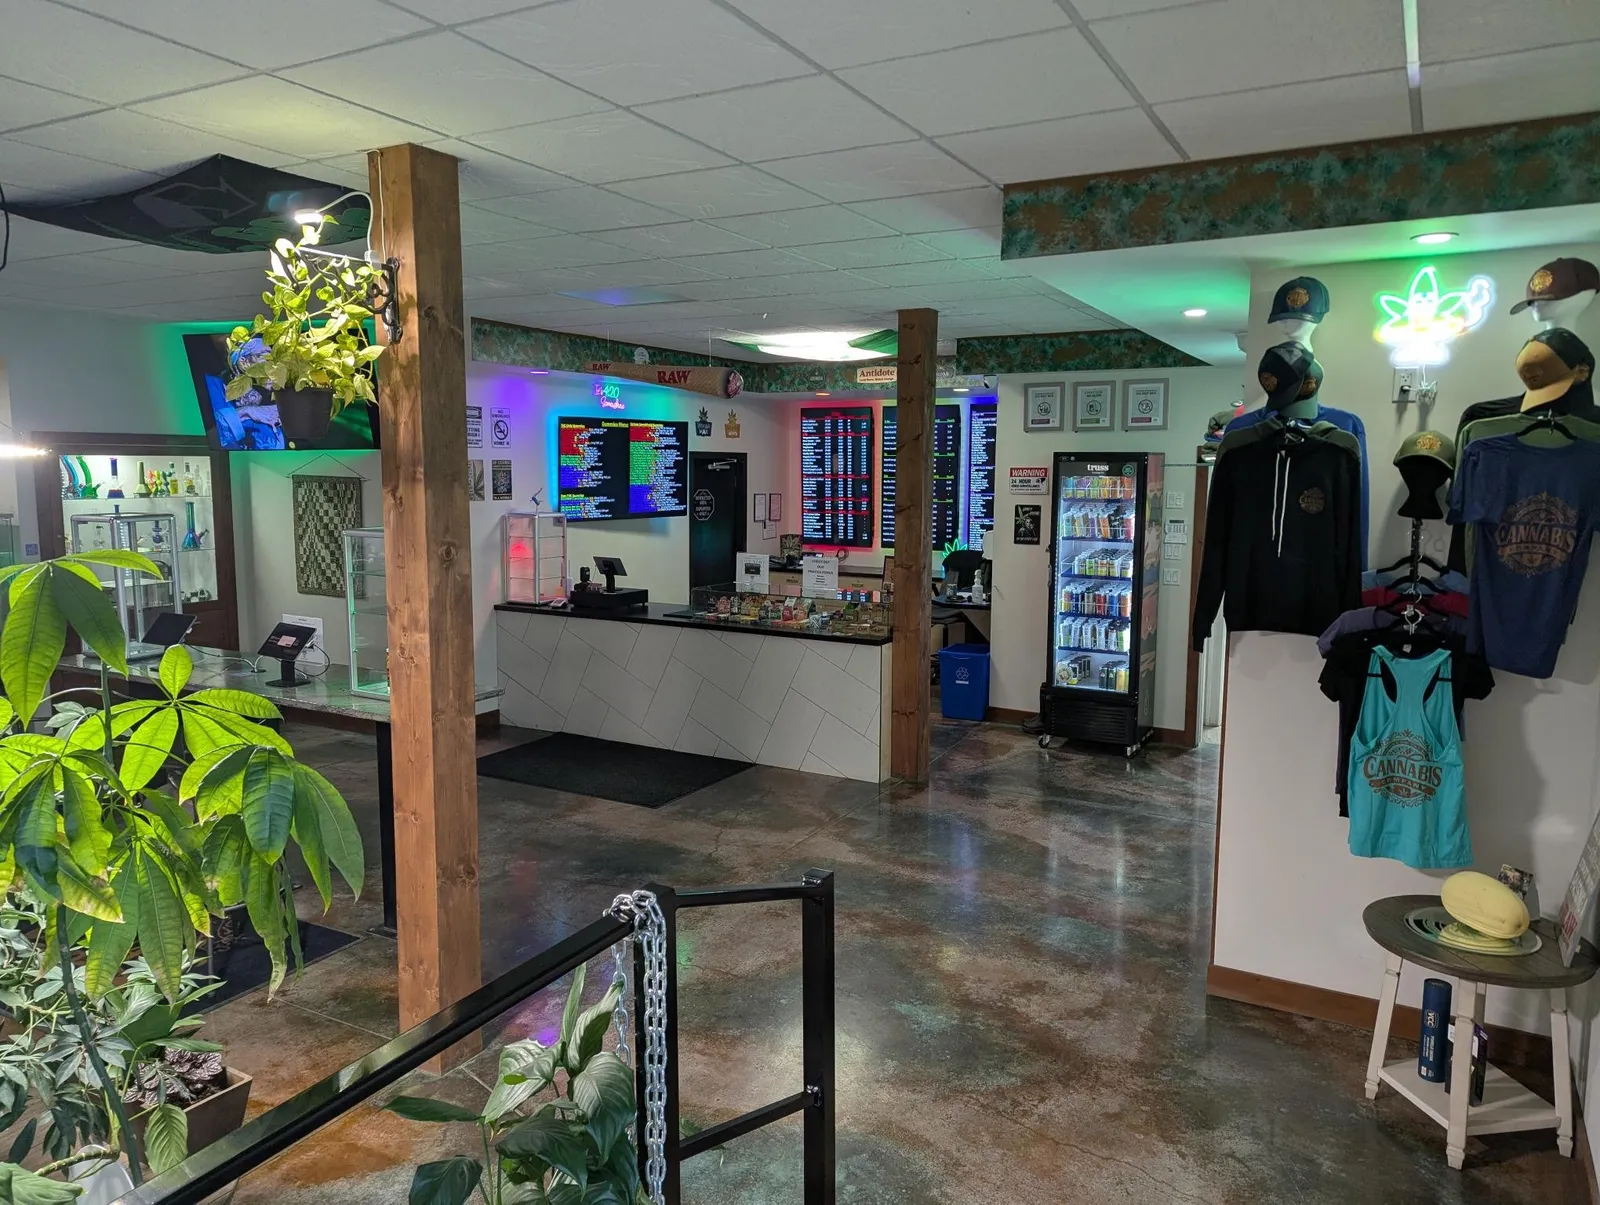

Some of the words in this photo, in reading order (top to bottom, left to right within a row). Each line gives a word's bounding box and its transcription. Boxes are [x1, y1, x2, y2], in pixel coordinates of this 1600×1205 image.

[592, 363, 611, 371] RAW
[859, 369, 895, 377] Antidote
[657, 370, 692, 384] RAW
[603, 385, 620, 398] 420
[1012, 469, 1045, 477] WARNING
[1494, 521, 1577, 553] CANNABIS
[1363, 755, 1442, 787] CANNABIS
[1381, 777, 1425, 791] COMPANY
[1427, 1012, 1435, 1027] VCC
